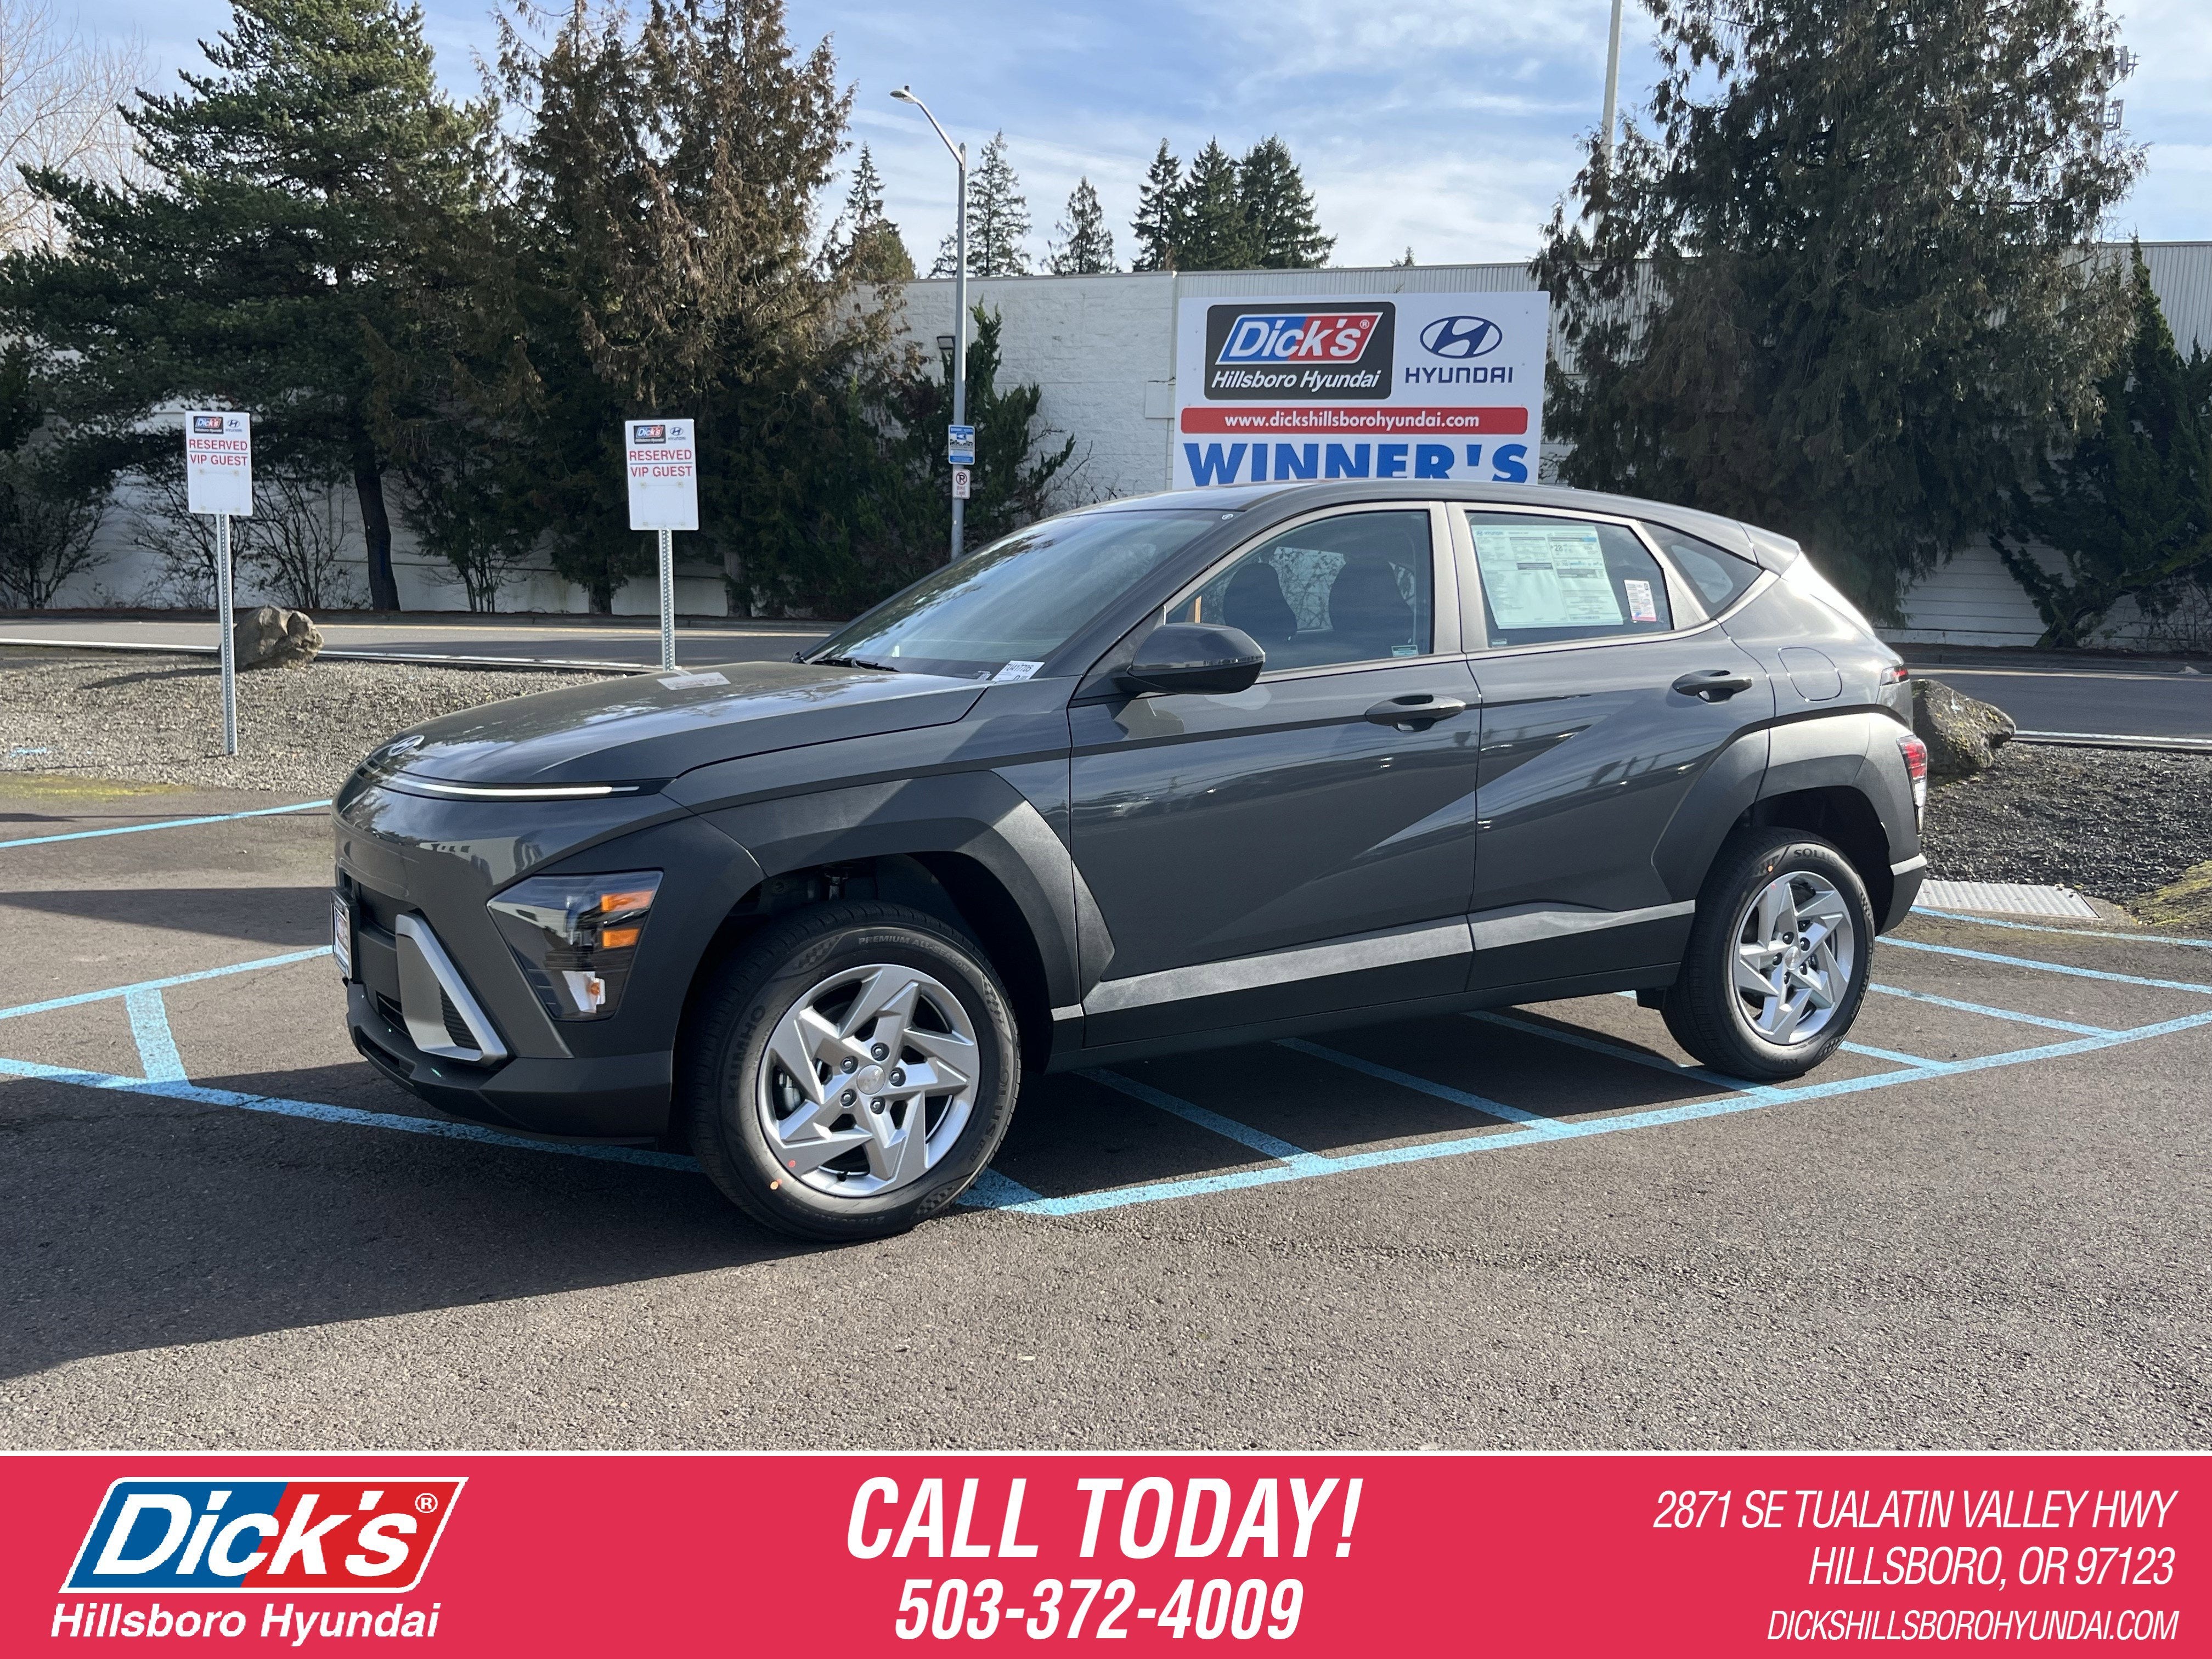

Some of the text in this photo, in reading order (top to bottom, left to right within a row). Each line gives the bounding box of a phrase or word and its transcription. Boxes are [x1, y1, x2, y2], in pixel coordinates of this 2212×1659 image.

[1211, 370, 1382, 392] Hillsboro Hyundai
[1406, 367, 1513, 383] HYUNDAI
[1225, 411, 1479, 432] www.dickshillsborohyundai.com
[189, 439, 247, 450] RESERVED
[190, 454, 247, 466] VIP GUEST
[629, 450, 692, 461] RESERVED
[631, 466, 692, 477] VIP GUEST
[1183, 443, 1528, 487] WINNER'S
[1793, 848, 1838, 866] SOLUS
[859, 935, 970, 973] PREMIUM ALL-SEASON
[985, 1052, 1009, 1138] SOLUS
